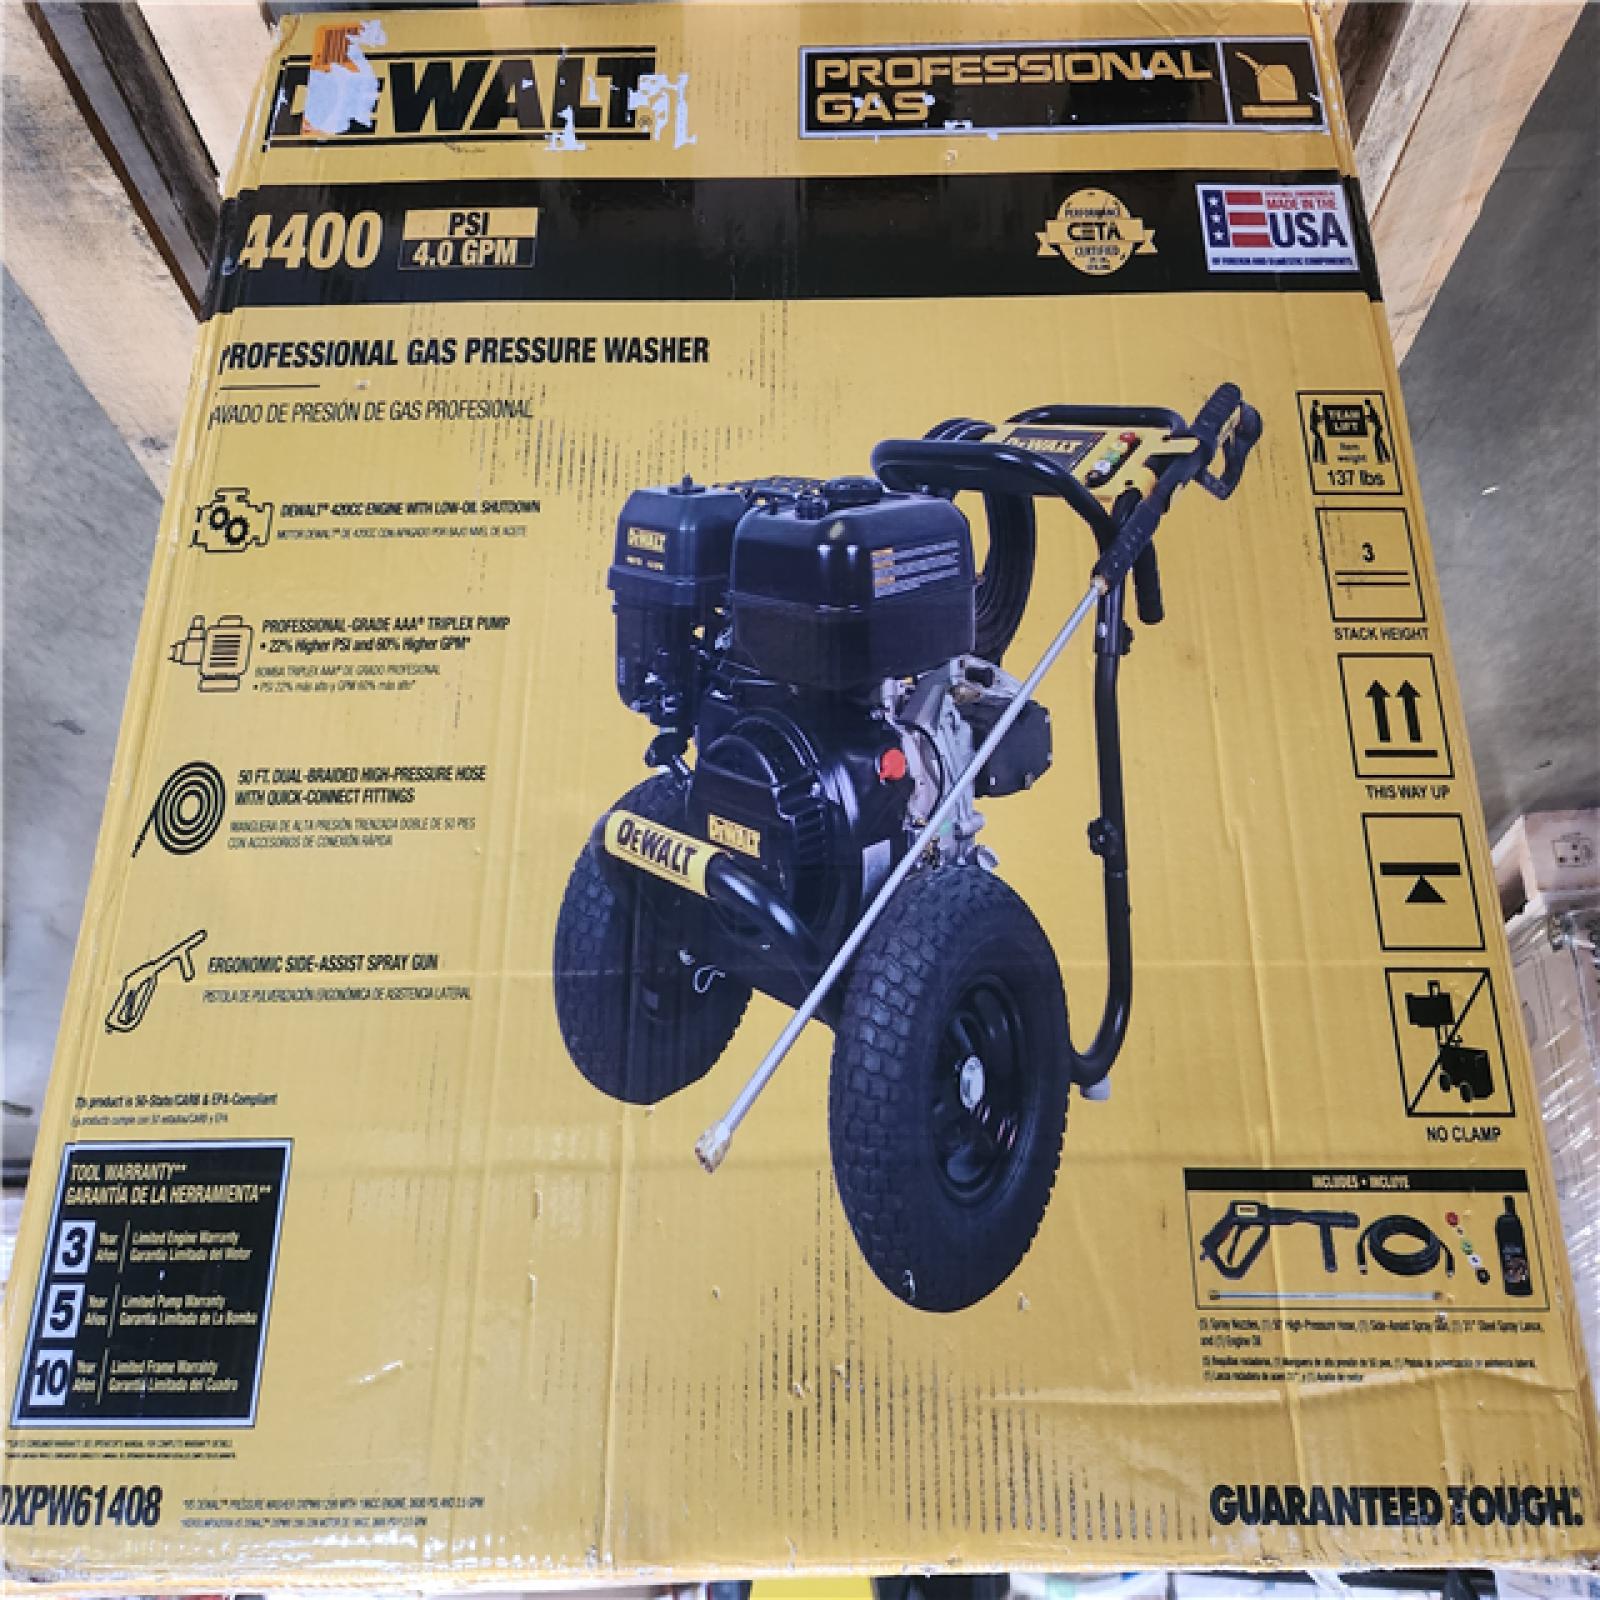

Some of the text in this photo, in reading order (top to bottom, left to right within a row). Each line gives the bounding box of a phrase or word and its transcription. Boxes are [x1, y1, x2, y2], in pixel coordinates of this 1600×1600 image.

[815, 50, 1213, 88] PROFESSIONAL
[815, 92, 928, 123] GAS
[448, 212, 489, 236] PSI
[1067, 222, 1121, 240] CETA
[1269, 212, 1348, 248] USA
[239, 211, 383, 269] 4400
[412, 239, 518, 267] 4.0 GPM
[406, 339, 456, 366] GAS
[464, 337, 595, 365] PRESSURE
[604, 337, 710, 363] WASHER
[267, 403, 289, 423] DE
[292, 399, 360, 423] PRESIÓN
[365, 402, 386, 421] DE
[390, 401, 422, 420] GAS
[426, 399, 534, 420] PROFESIONAL
[1328, 469, 1385, 486] 137 lbs
[1362, 542, 1375, 562] 3
[262, 617, 390, 632] PROFESSIONAL-GRADE
[428, 616, 474, 631] TRIPLEX
[477, 616, 510, 630] PUMP
[1334, 627, 1428, 641] STACK HEIGHT
[269, 640, 293, 653] 22%
[295, 639, 330, 656] Higher
[333, 638, 350, 652] PSI
[353, 638, 373, 652] and
[402, 637, 438, 654] Higher
[237, 769, 252, 784] 50
[272, 767, 358, 783] DUAL-BRAIDED
[360, 765, 453, 782] HIGH-PRESSURE
[455, 764, 487, 781] HOSE
[235, 787, 415, 805] WITH QUICK-CONNECT FITTINGS
[1366, 785, 1450, 799] THIS WAY UP
[208, 954, 438, 972] ERGONOMIC SIDE-ASSIST SPRAY GUN
[1427, 1127, 1501, 1142] NO CLAMP
[71, 1165, 100, 1180] TOOL
[130, 1187, 148, 1204] DE
[150, 1186, 167, 1203] LA
[62, 1227, 88, 1267] 3
[50, 1290, 76, 1330] 5
[36, 1359, 67, 1395] 10
[1210, 1484, 1443, 1526] GUARANTEED
